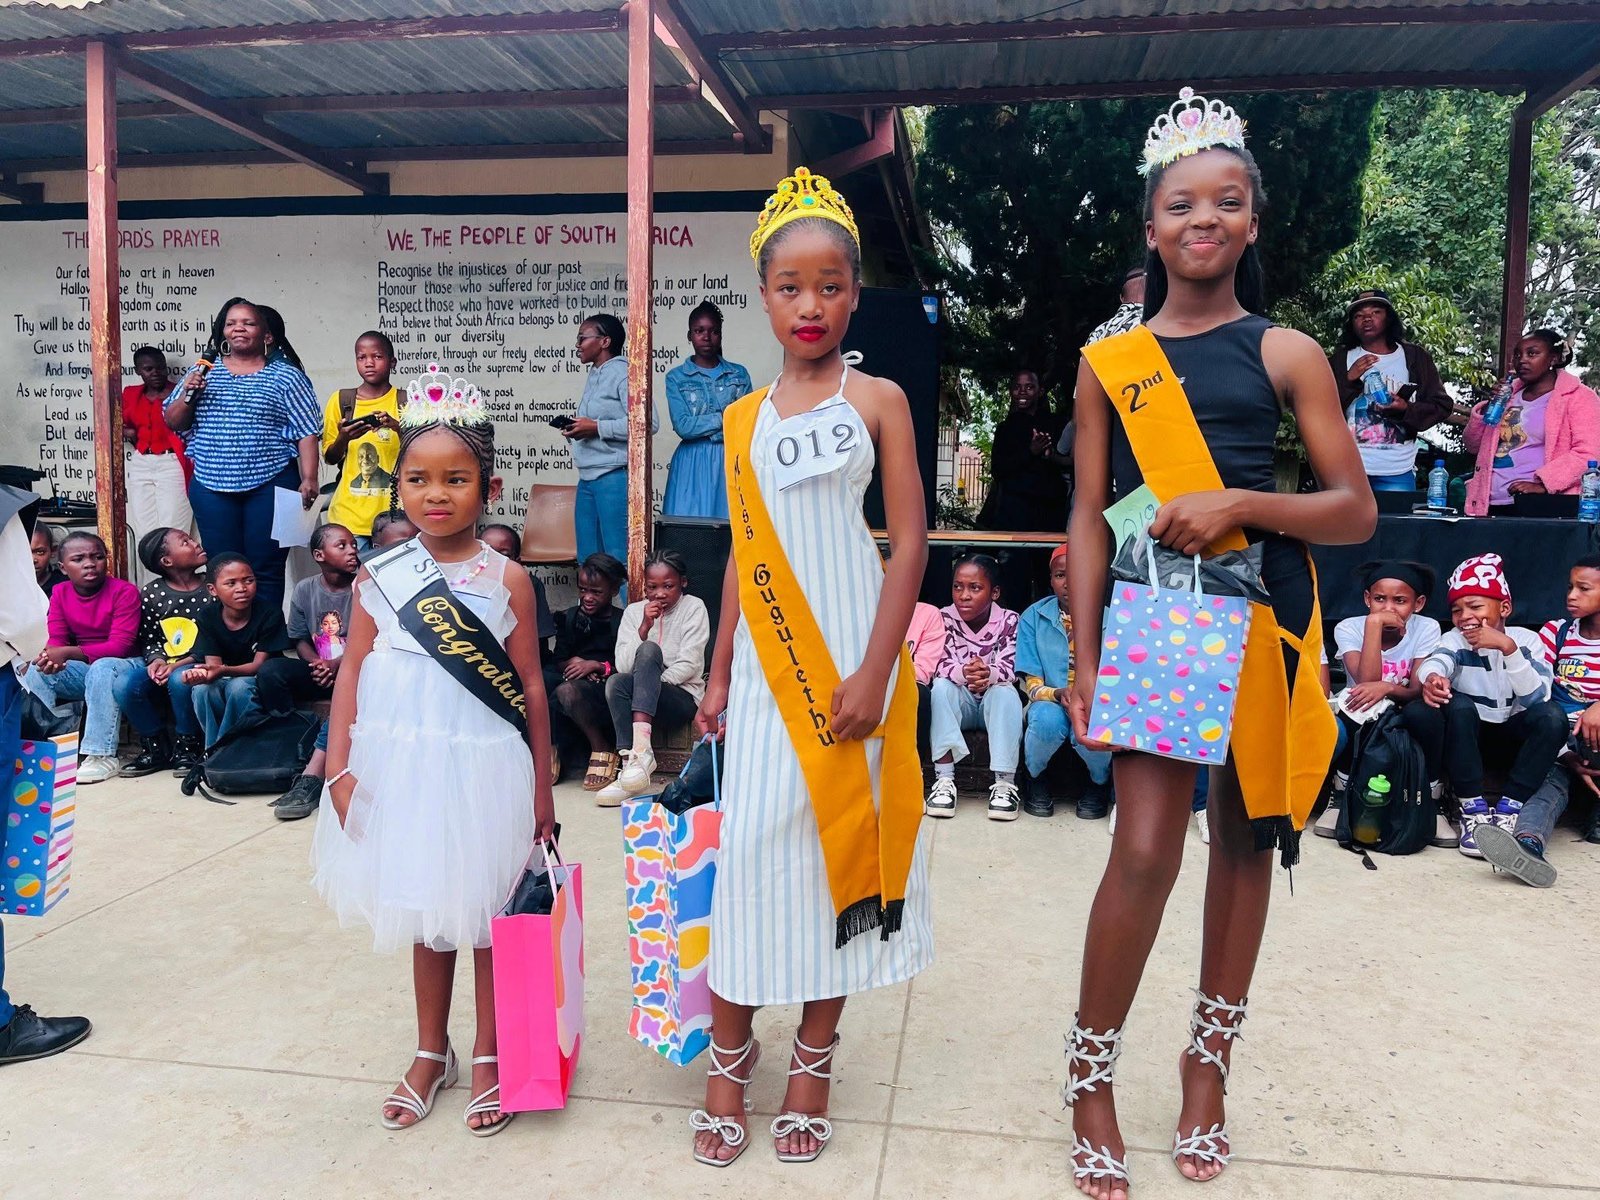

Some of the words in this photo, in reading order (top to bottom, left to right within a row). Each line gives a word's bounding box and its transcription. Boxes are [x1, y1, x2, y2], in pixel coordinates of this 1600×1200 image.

[62, 231, 89, 249] TH
[118, 227, 154, 249] ORD'S
[164, 230, 219, 248] PRAYER
[421, 228, 451, 248] THE
[461, 226, 525, 245] PEOPLE
[535, 226, 553, 245] OF
[561, 225, 615, 244] SOUTH
[652, 225, 693, 247] RICA
[56, 267, 72, 279] Our
[141, 267, 156, 278] art
[163, 267, 170, 279] in
[179, 264, 214, 277] heaven
[379, 261, 432, 282] Recognise
[438, 262, 453, 276] the
[458, 262, 507, 280] injustices
[516, 259, 527, 274] of
[532, 264, 552, 274] our
[558, 261, 581, 281] past
[137, 282, 153, 298] thy
[167, 286, 197, 295] name
[379, 280, 416, 296] Honour
[425, 281, 452, 294] those
[460, 279, 481, 293] who
[489, 278, 532, 292] suffered
[537, 277, 552, 291] for
[554, 276, 586, 296] justice
[590, 277, 609, 290] and
[665, 276, 673, 290] in
[678, 278, 697, 289] our
[703, 274, 727, 289] land
[156, 302, 181, 311] come
[379, 297, 423, 317] Respect
[425, 297, 453, 312] those
[460, 298, 481, 312] who
[487, 296, 513, 310] have
[520, 295, 559, 310] worked
[567, 295, 577, 309] to
[581, 294, 606, 308] build
[681, 295, 699, 307] our
[703, 290, 747, 309] country
[14, 314, 34, 336] Thy
[40, 317, 57, 330] will
[62, 317, 73, 330] be
[154, 322, 166, 331] as
[171, 319, 177, 331] it
[181, 319, 189, 331] is
[197, 319, 205, 331] in
[379, 315, 397, 328] And
[401, 313, 431, 328] believe
[434, 315, 452, 327] that
[456, 313, 482, 326] South
[485, 312, 514, 326] Africa
[519, 312, 554, 329] belongs
[558, 311, 568, 324] to
[417, 334, 425, 342] in
[435, 334, 451, 342] our
[462, 329, 505, 347] diversity
[34, 340, 57, 354] Give
[63, 343, 74, 352] us
[443, 346, 477, 361] through
[483, 350, 497, 358] our
[534, 346, 565, 358] elected
[46, 363, 63, 376] And
[468, 361, 481, 373] the
[487, 362, 524, 378] supreme
[552, 360, 561, 372] of
[566, 361, 580, 373] the
[17, 383, 29, 397] As
[34, 389, 47, 397] we
[51, 384, 82, 400] forgive
[495, 388, 514, 401] past
[1121, 370, 1164, 414] 2nd
[529, 399, 577, 410] democratic
[45, 405, 69, 421] Lead
[76, 412, 87, 420] us
[46, 425, 66, 441] But
[40, 444, 56, 460] For
[63, 444, 88, 460] thine
[528, 446, 536, 456] in
[542, 445, 570, 457] which
[777, 423, 857, 466] 012
[65, 464, 82, 479] the
[496, 457, 512, 469] the
[517, 457, 548, 475] people
[553, 458, 572, 469] and
[513, 488, 528, 501] life
[754, 563, 836, 747] Gugulethu
